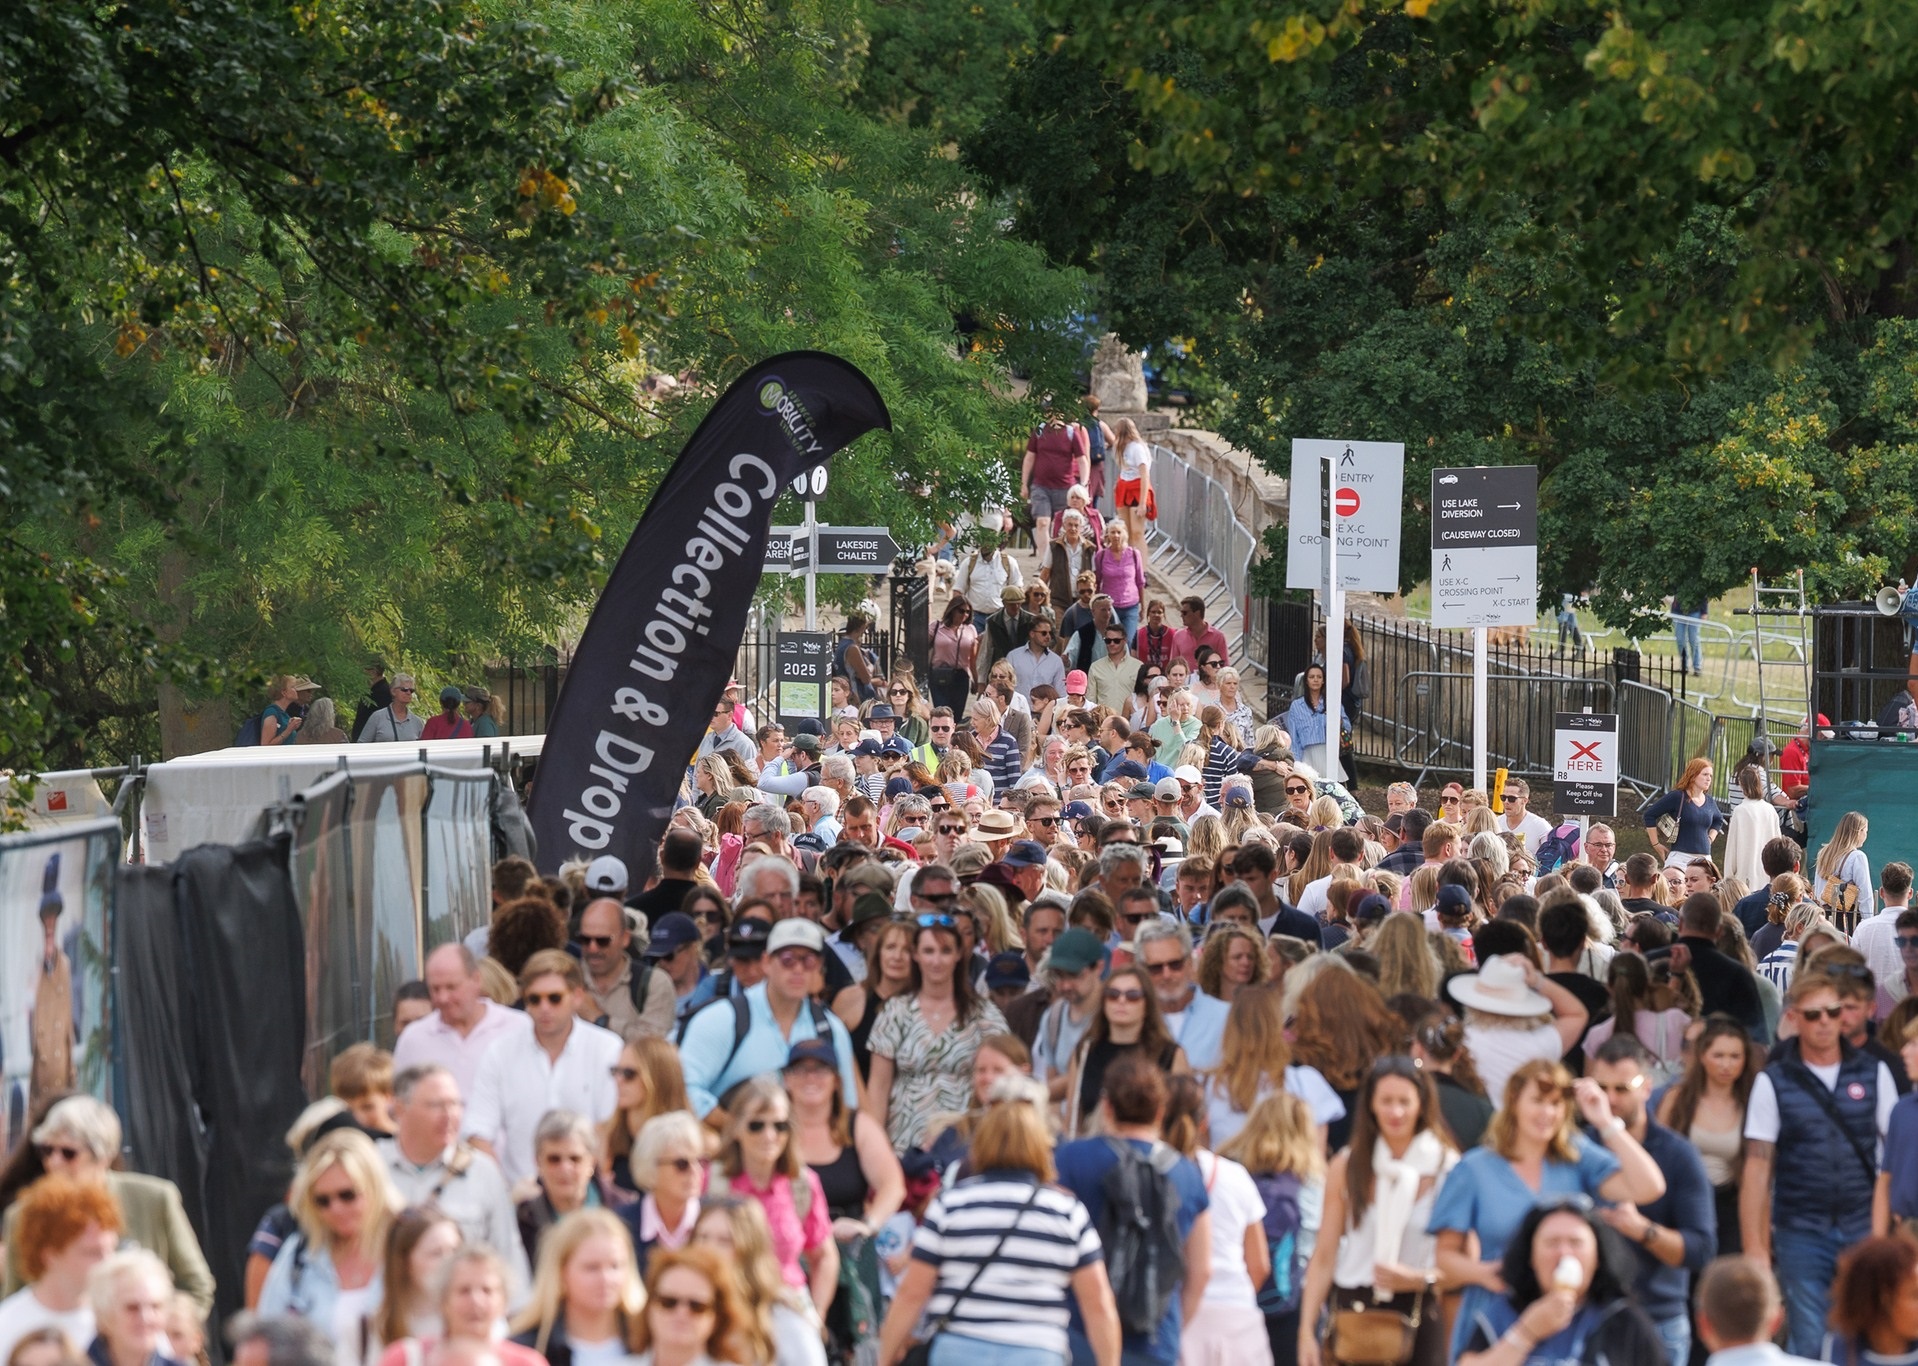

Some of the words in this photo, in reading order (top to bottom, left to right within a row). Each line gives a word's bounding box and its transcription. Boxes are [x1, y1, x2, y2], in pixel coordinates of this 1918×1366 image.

[763, 384, 823, 453] MOBILITY
[1340, 473, 1374, 482] ENTRY
[1442, 500, 1456, 508] USE
[1458, 499, 1478, 507] LAKE
[1442, 510, 1483, 518] DIVERSION
[1346, 524, 1365, 534] X-C
[1442, 530, 1486, 540] (CAUSEWAY
[1488, 528, 1520, 538] CLOSED)
[836, 540, 878, 550] LAKESIDE
[1299, 535, 1354, 547] CRONG
[1356, 538, 1390, 548] POINT
[837, 552, 877, 560] CHALETS
[629, 452, 777, 682] Collection
[1439, 588, 1478, 596] CROSSING
[1480, 587, 1503, 595] POINT
[1492, 599, 1506, 607] X-C
[784, 662, 816, 676] 2025
[610, 686, 670, 728] &
[1567, 760, 1602, 772] HERE
[1558, 772, 1568, 780] R8
[562, 729, 656, 851] Drop
[1566, 790, 1582, 798] Keep
